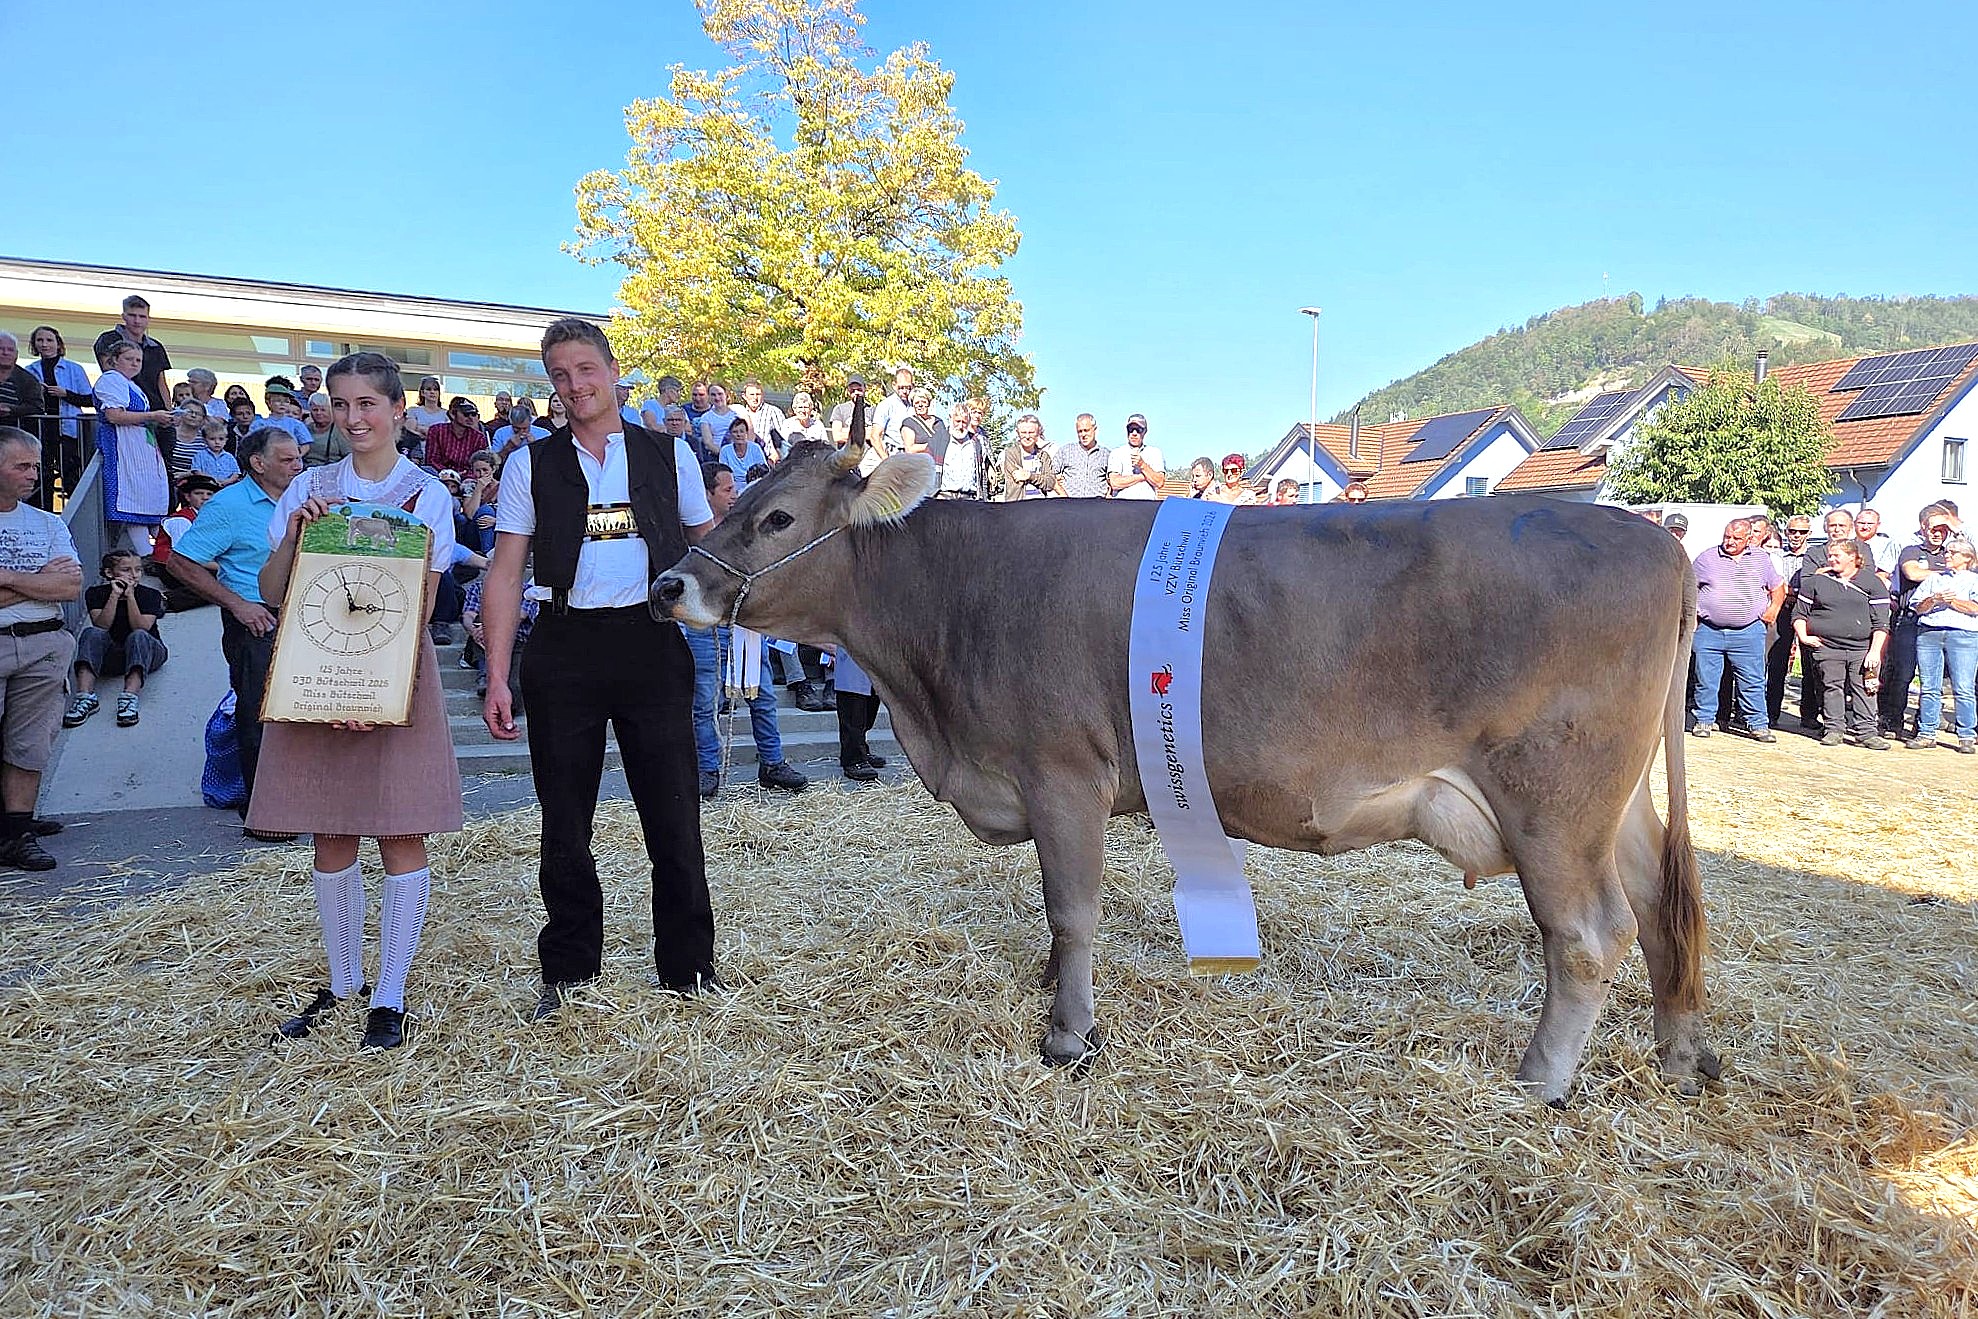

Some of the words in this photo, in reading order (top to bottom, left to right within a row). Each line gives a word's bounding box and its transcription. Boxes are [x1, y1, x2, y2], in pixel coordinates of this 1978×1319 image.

[1156, 541, 1171, 565] Jahre
[1189, 527, 1209, 566] Braunvieh
[1150, 565, 1164, 582] 125
[1165, 573, 1179, 596] VZV
[1181, 567, 1198, 604] Original
[1178, 606, 1191, 632] Miss
[302, 689, 326, 698] Miss
[1157, 702, 1190, 810] swissgenetics
